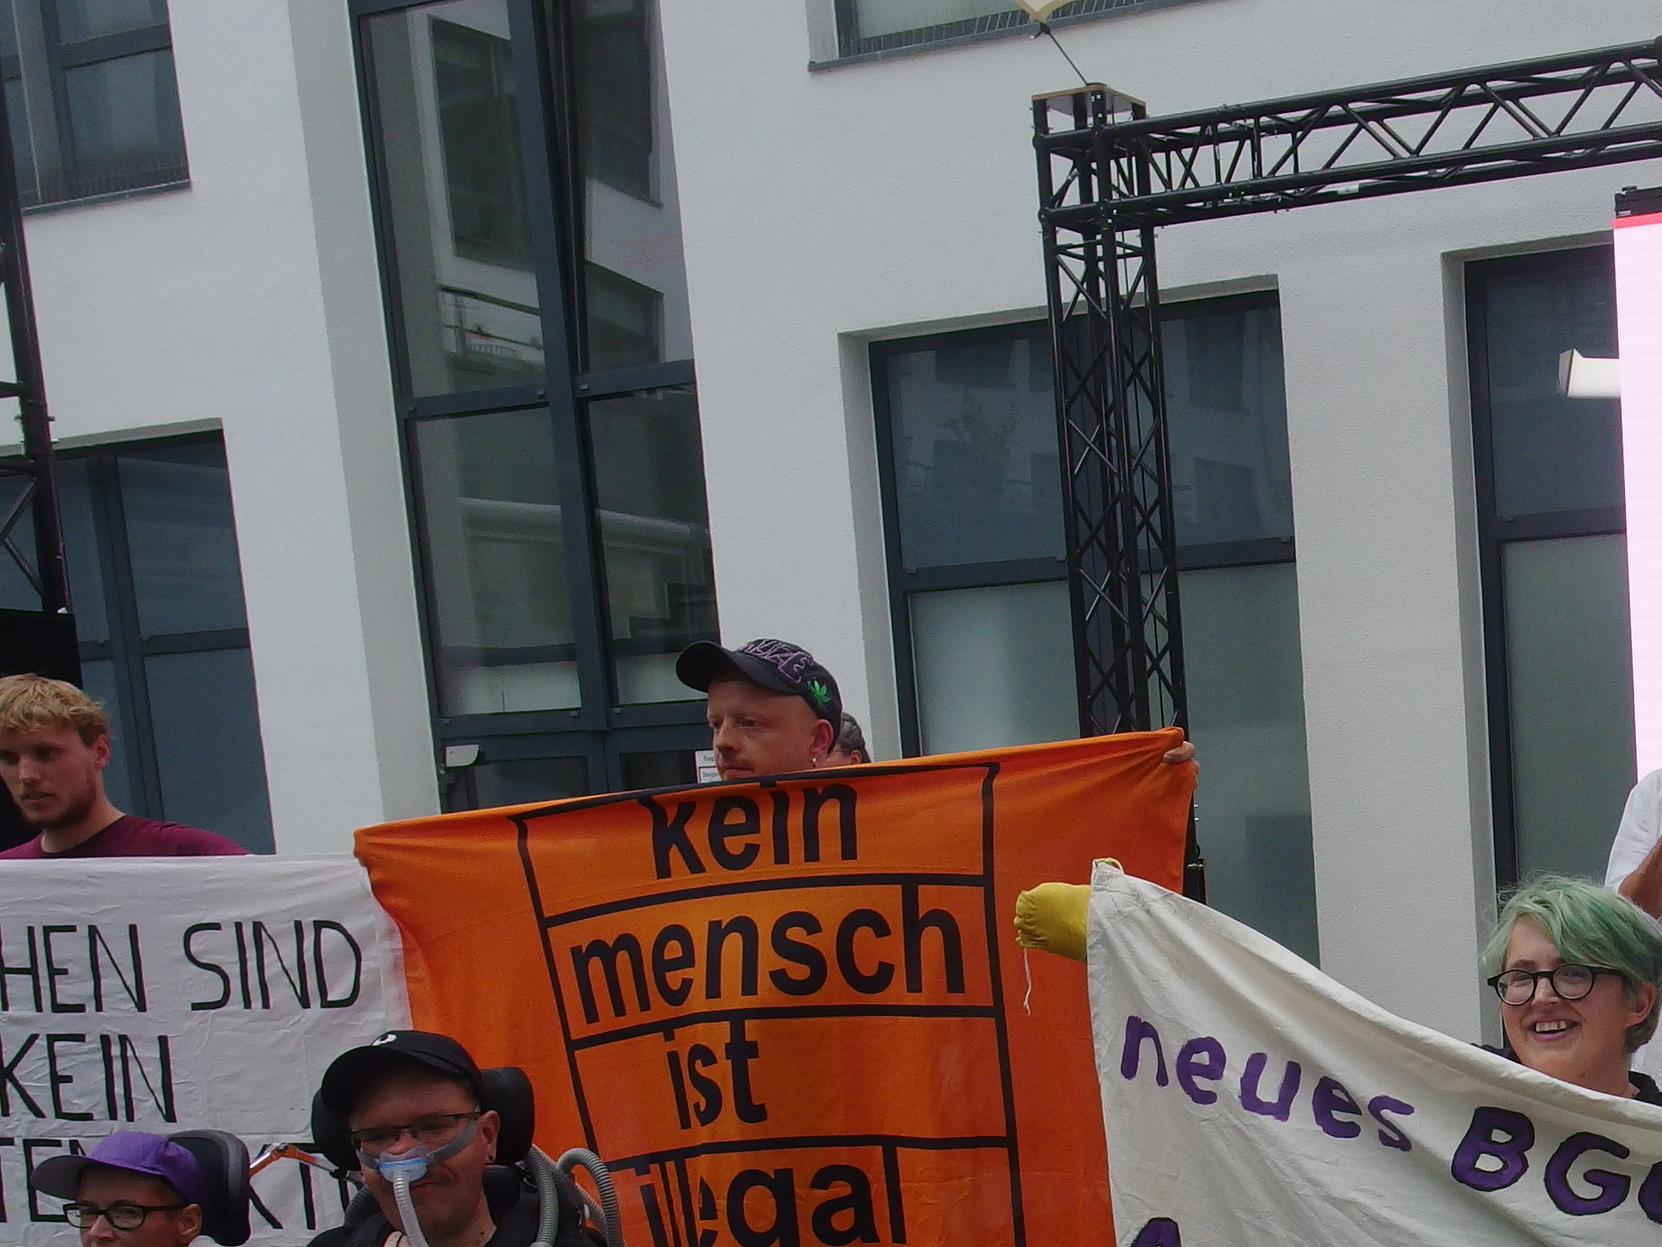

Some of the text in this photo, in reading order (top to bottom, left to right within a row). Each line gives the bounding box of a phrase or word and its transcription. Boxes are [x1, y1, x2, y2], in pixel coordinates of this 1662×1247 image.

[651, 779, 861, 882] kein
[183, 920, 362, 1012] SIND
[569, 885, 967, 1024] mensch
[0, 1033, 178, 1123] KEIN
[663, 1020, 769, 1131] ist
[1120, 1013, 1414, 1153] neues
